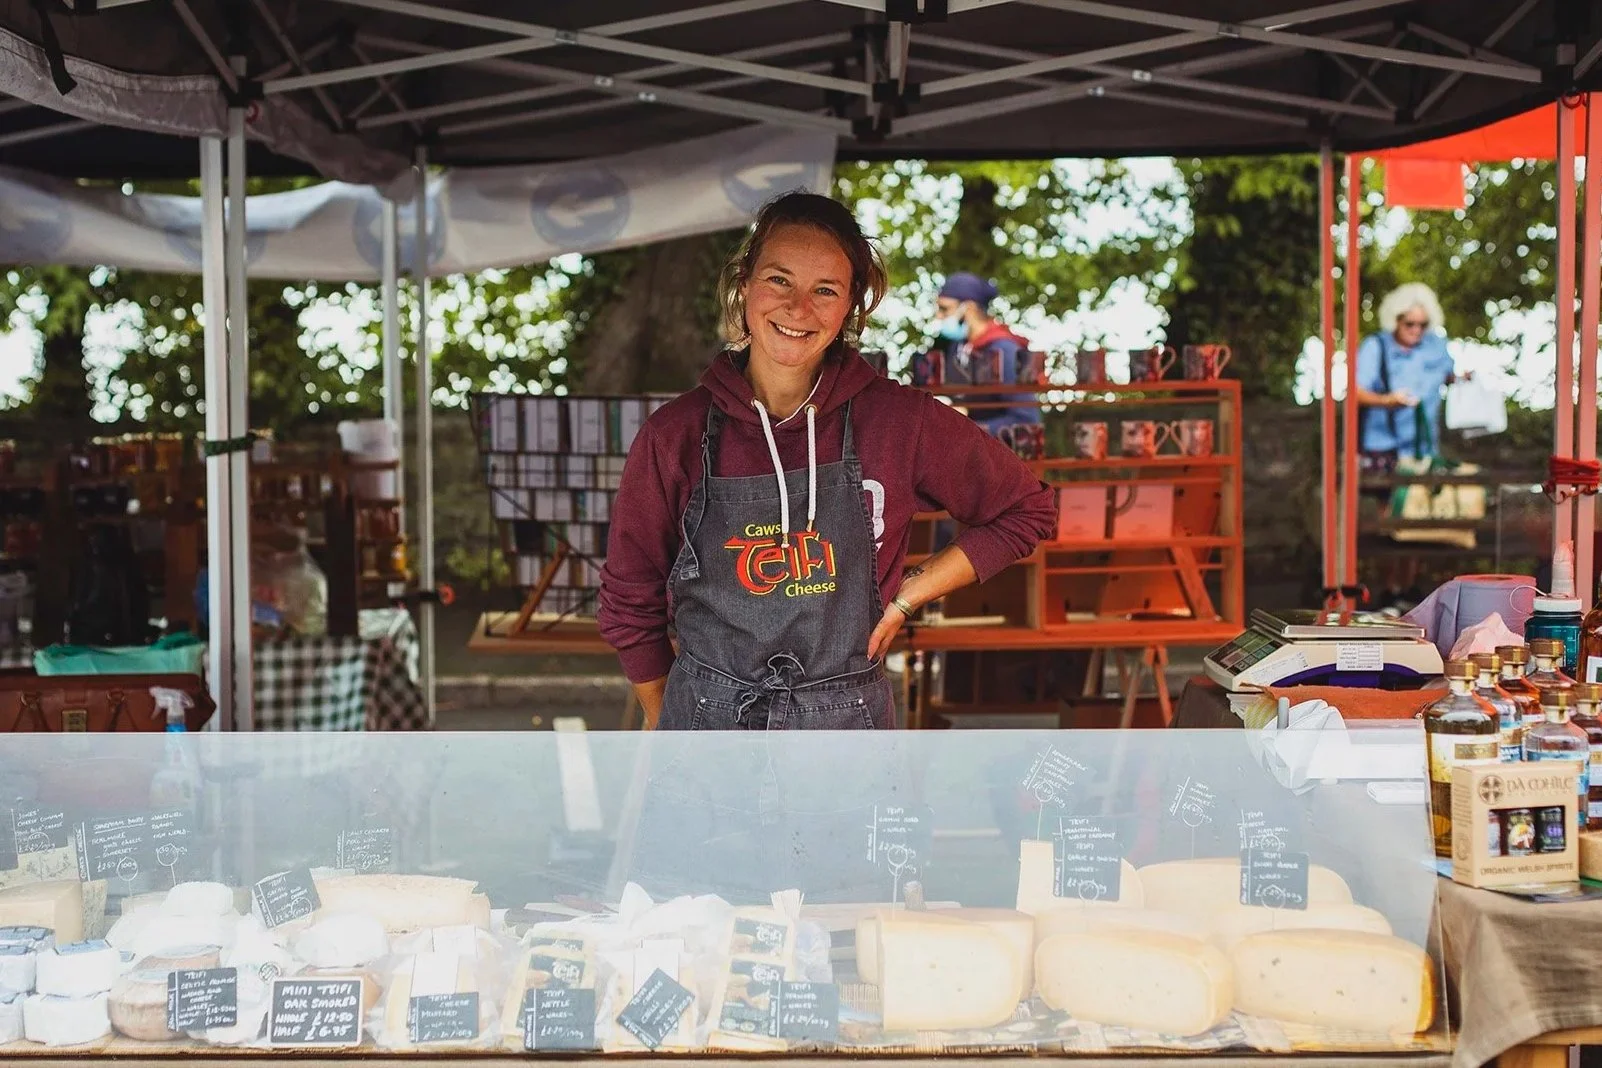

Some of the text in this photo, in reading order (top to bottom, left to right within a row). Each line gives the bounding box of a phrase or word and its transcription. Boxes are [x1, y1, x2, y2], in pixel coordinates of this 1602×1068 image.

[745, 523, 781, 537] Caws
[785, 581, 836, 597] Cheese
[282, 983, 353, 996] MINI TEIFI
[284, 995, 357, 1009] OAK SMOKED
[541, 999, 571, 1009] NETTLE
[275, 1012, 308, 1023] WHOLE
[273, 1025, 301, 1037] HALF
